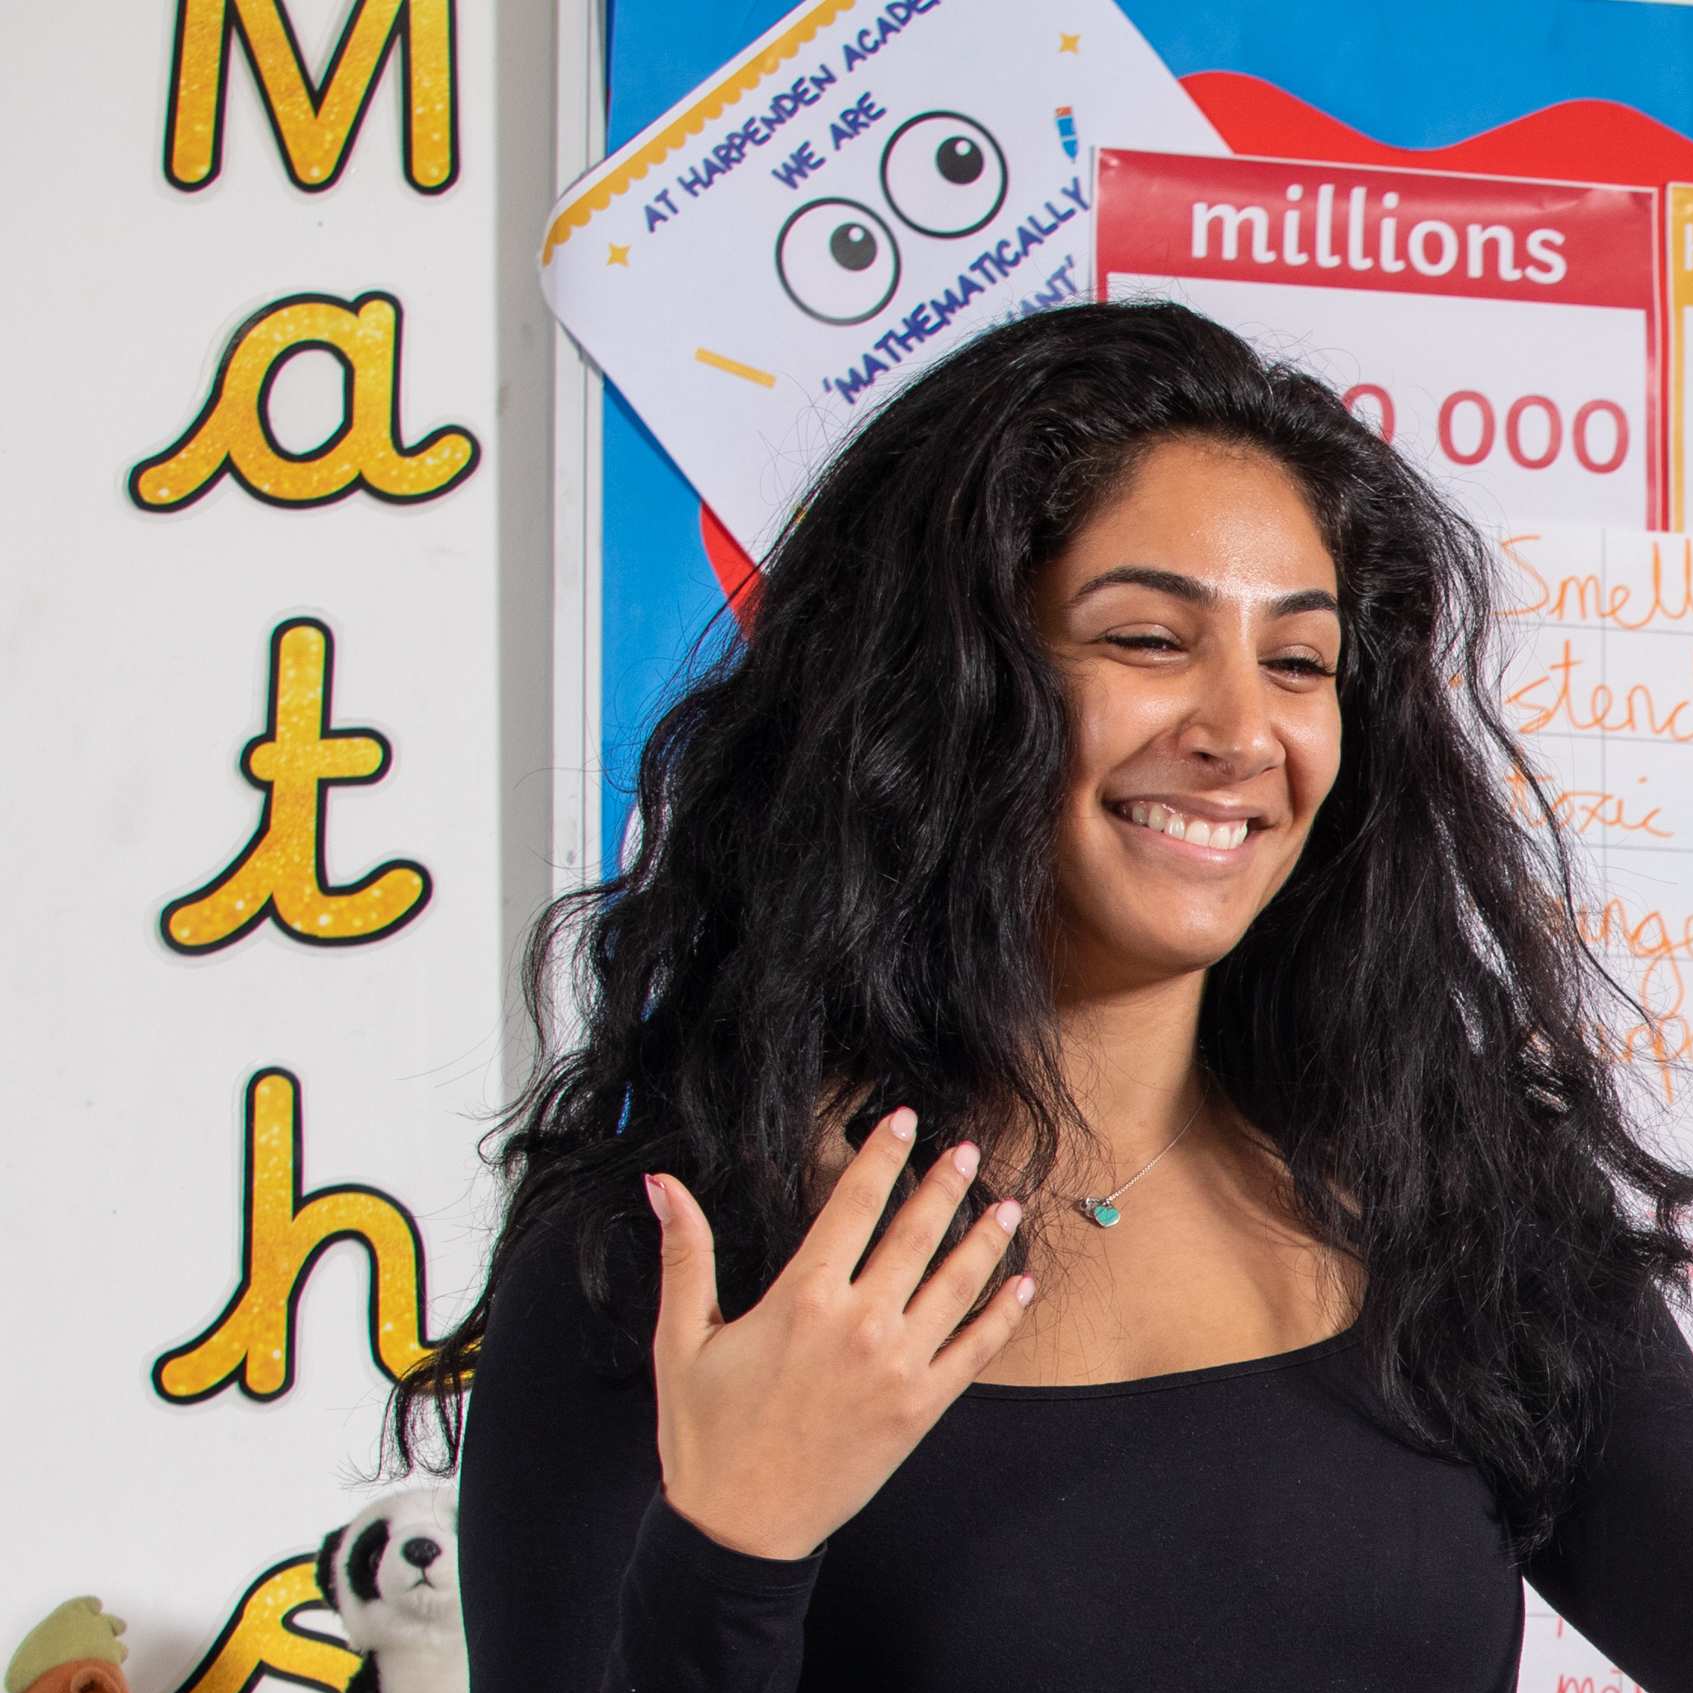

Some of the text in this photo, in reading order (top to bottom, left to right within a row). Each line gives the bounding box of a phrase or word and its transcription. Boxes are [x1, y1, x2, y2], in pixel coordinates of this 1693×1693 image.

[642, 193, 680, 234] AT
[680, 63, 838, 201] HARPENDEN
[771, 90, 888, 192] WE ARE
[1192, 182, 1568, 285] millions
